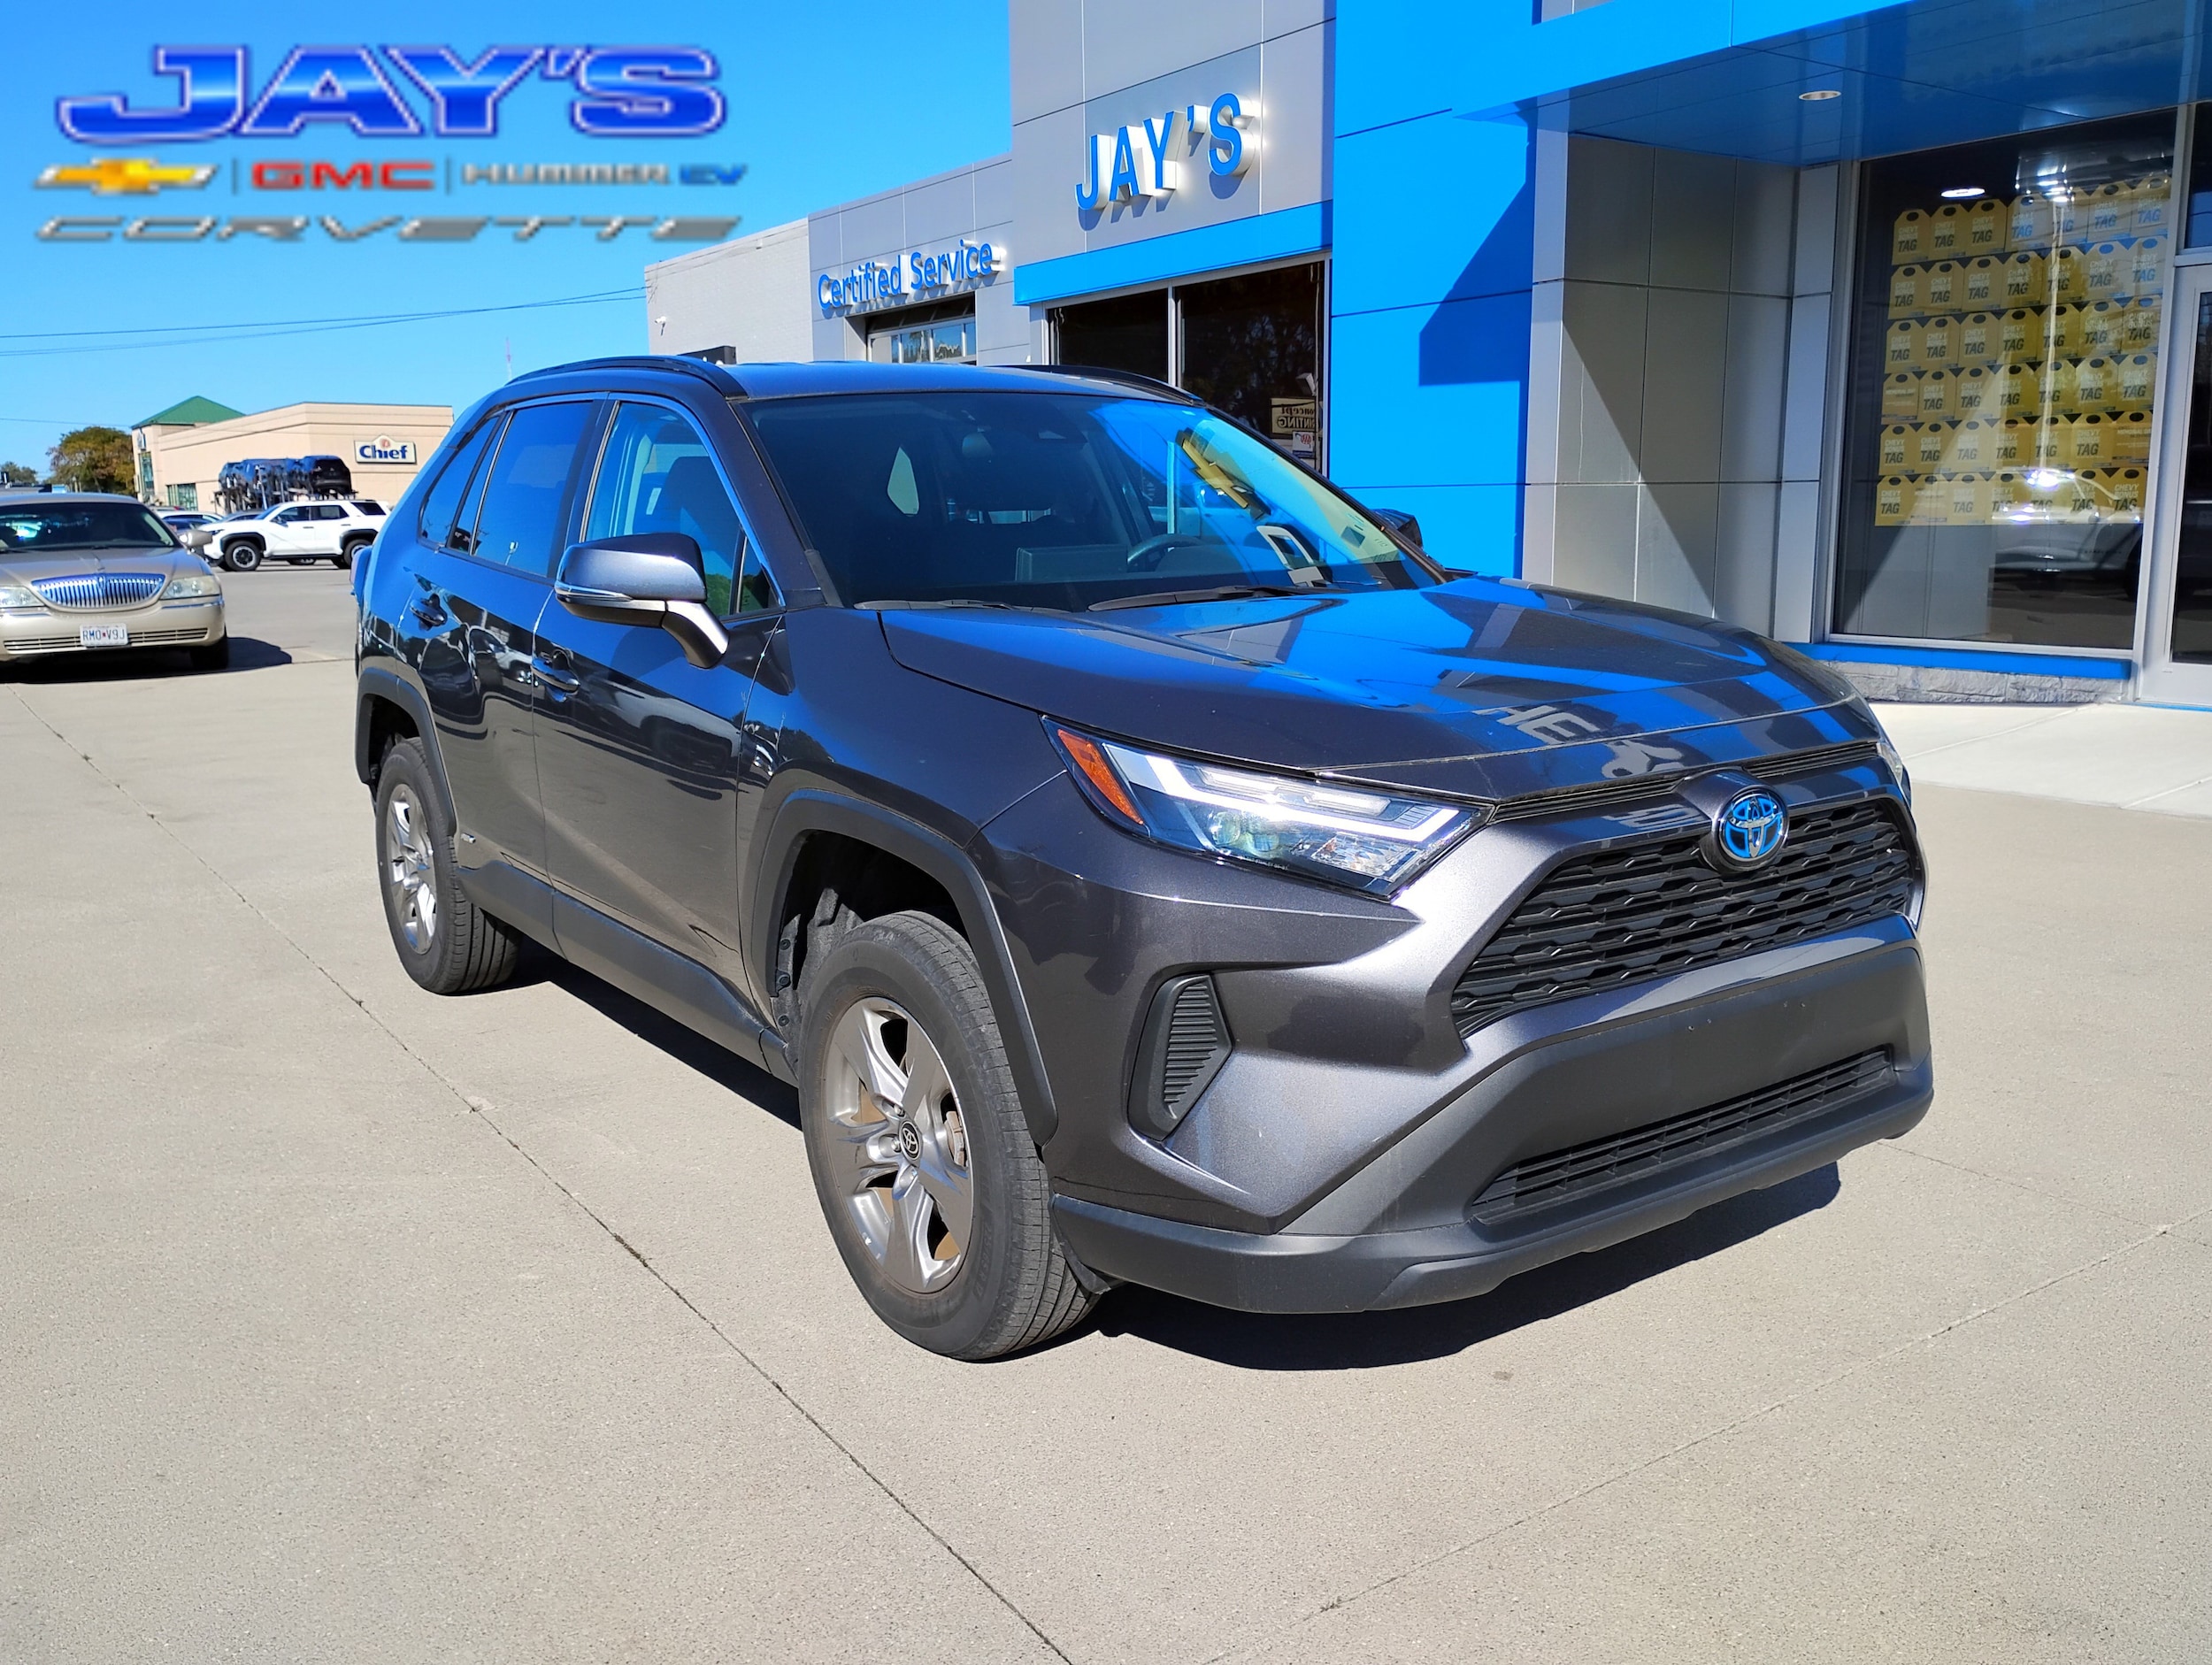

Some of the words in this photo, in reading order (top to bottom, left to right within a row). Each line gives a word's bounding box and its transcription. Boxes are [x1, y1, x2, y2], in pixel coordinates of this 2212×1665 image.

[1075, 93, 1244, 210] JAY'S
[818, 255, 902, 310] Certified
[910, 239, 993, 290] Service
[2039, 391, 2061, 403] TG
[359, 444, 408, 459] Chief
